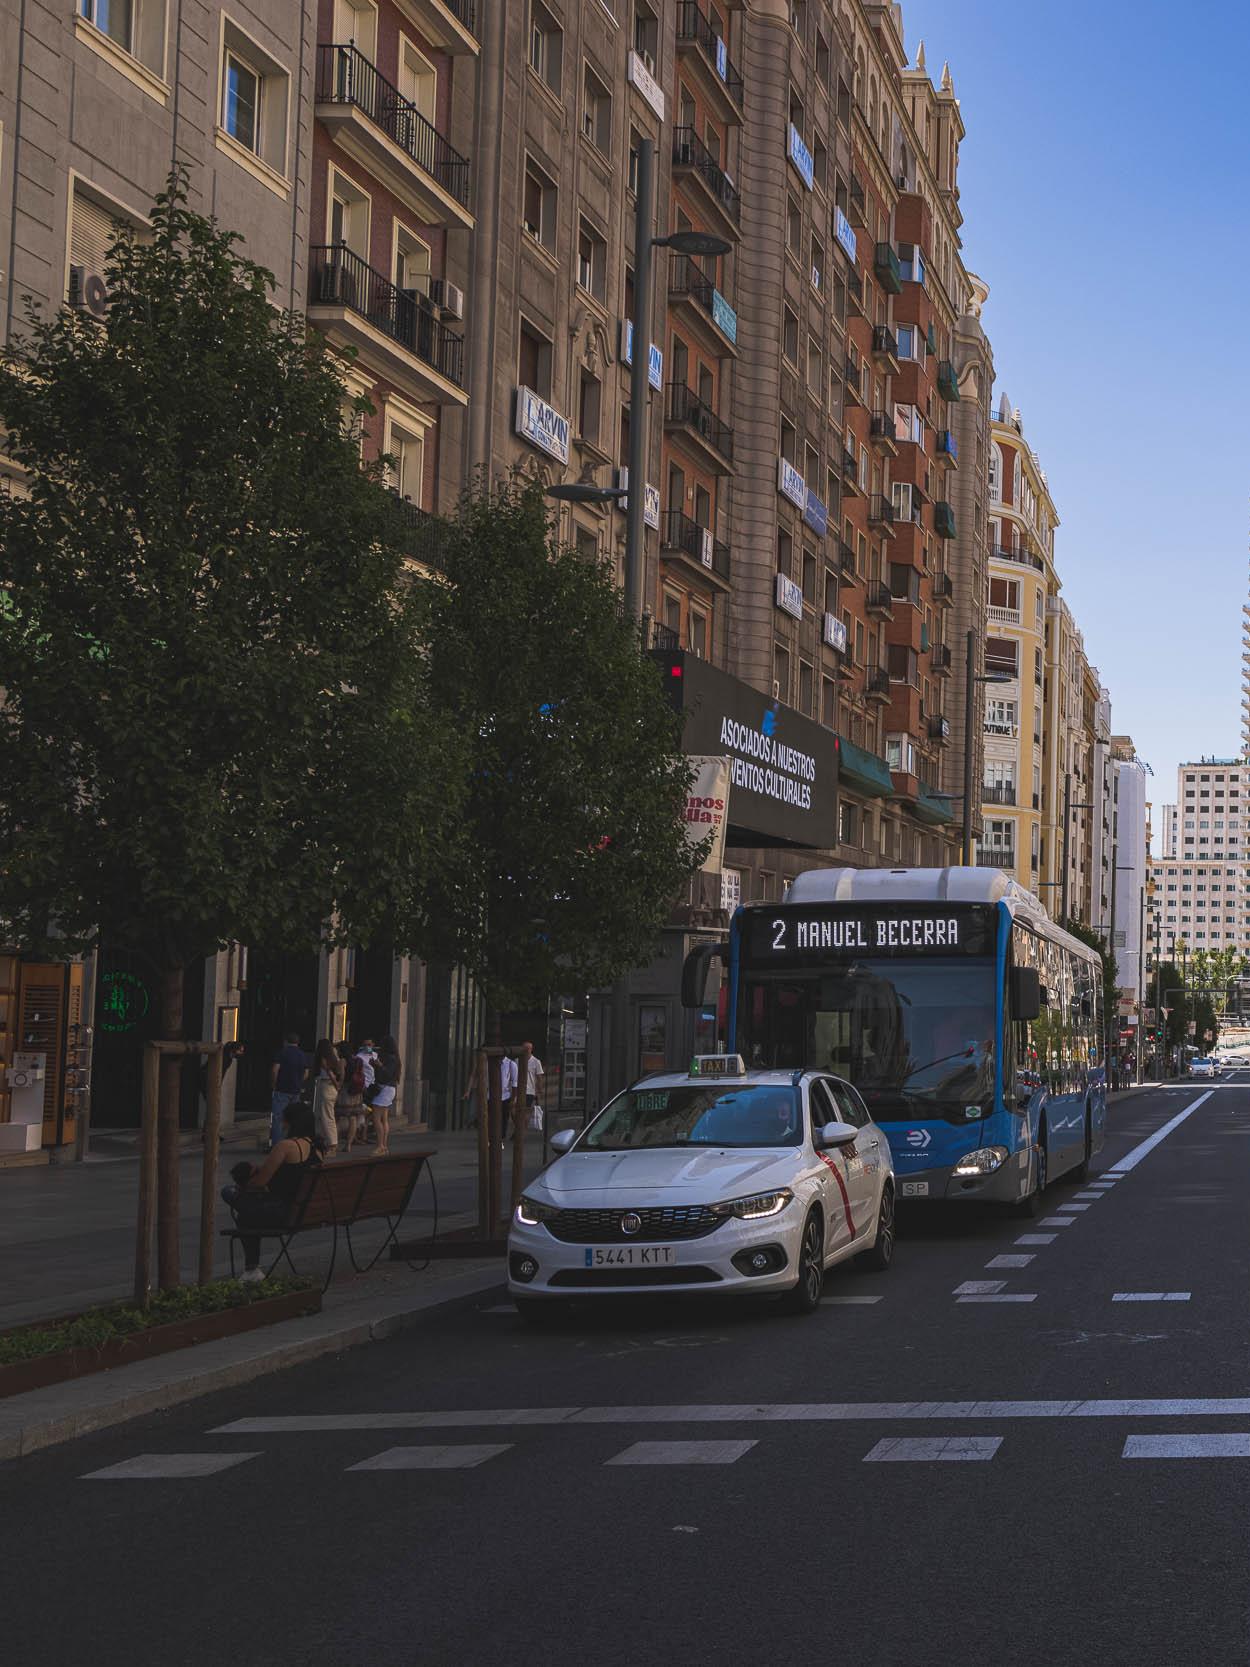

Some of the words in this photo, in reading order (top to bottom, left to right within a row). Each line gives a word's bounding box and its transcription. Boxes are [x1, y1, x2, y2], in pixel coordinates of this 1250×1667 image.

[527, 394, 569, 446] LARVIN
[983, 724, 1010, 735] OUTIQUE
[720, 716, 771, 762] ASOCIADOS
[771, 740, 777, 767] A
[777, 743, 815, 781] NUESTROS
[726, 754, 764, 794] VENTOS
[765, 769, 811, 810] CULTURALES
[772, 919, 786, 949] 2
[797, 921, 867, 948] MANUEL
[876, 919, 958, 946] BECERRA
[704, 1060, 725, 1073] TAXI
[905, 1183, 926, 1195] SP
[595, 1248, 633, 1265] 5441
[641, 1247, 671, 1263] KTT
